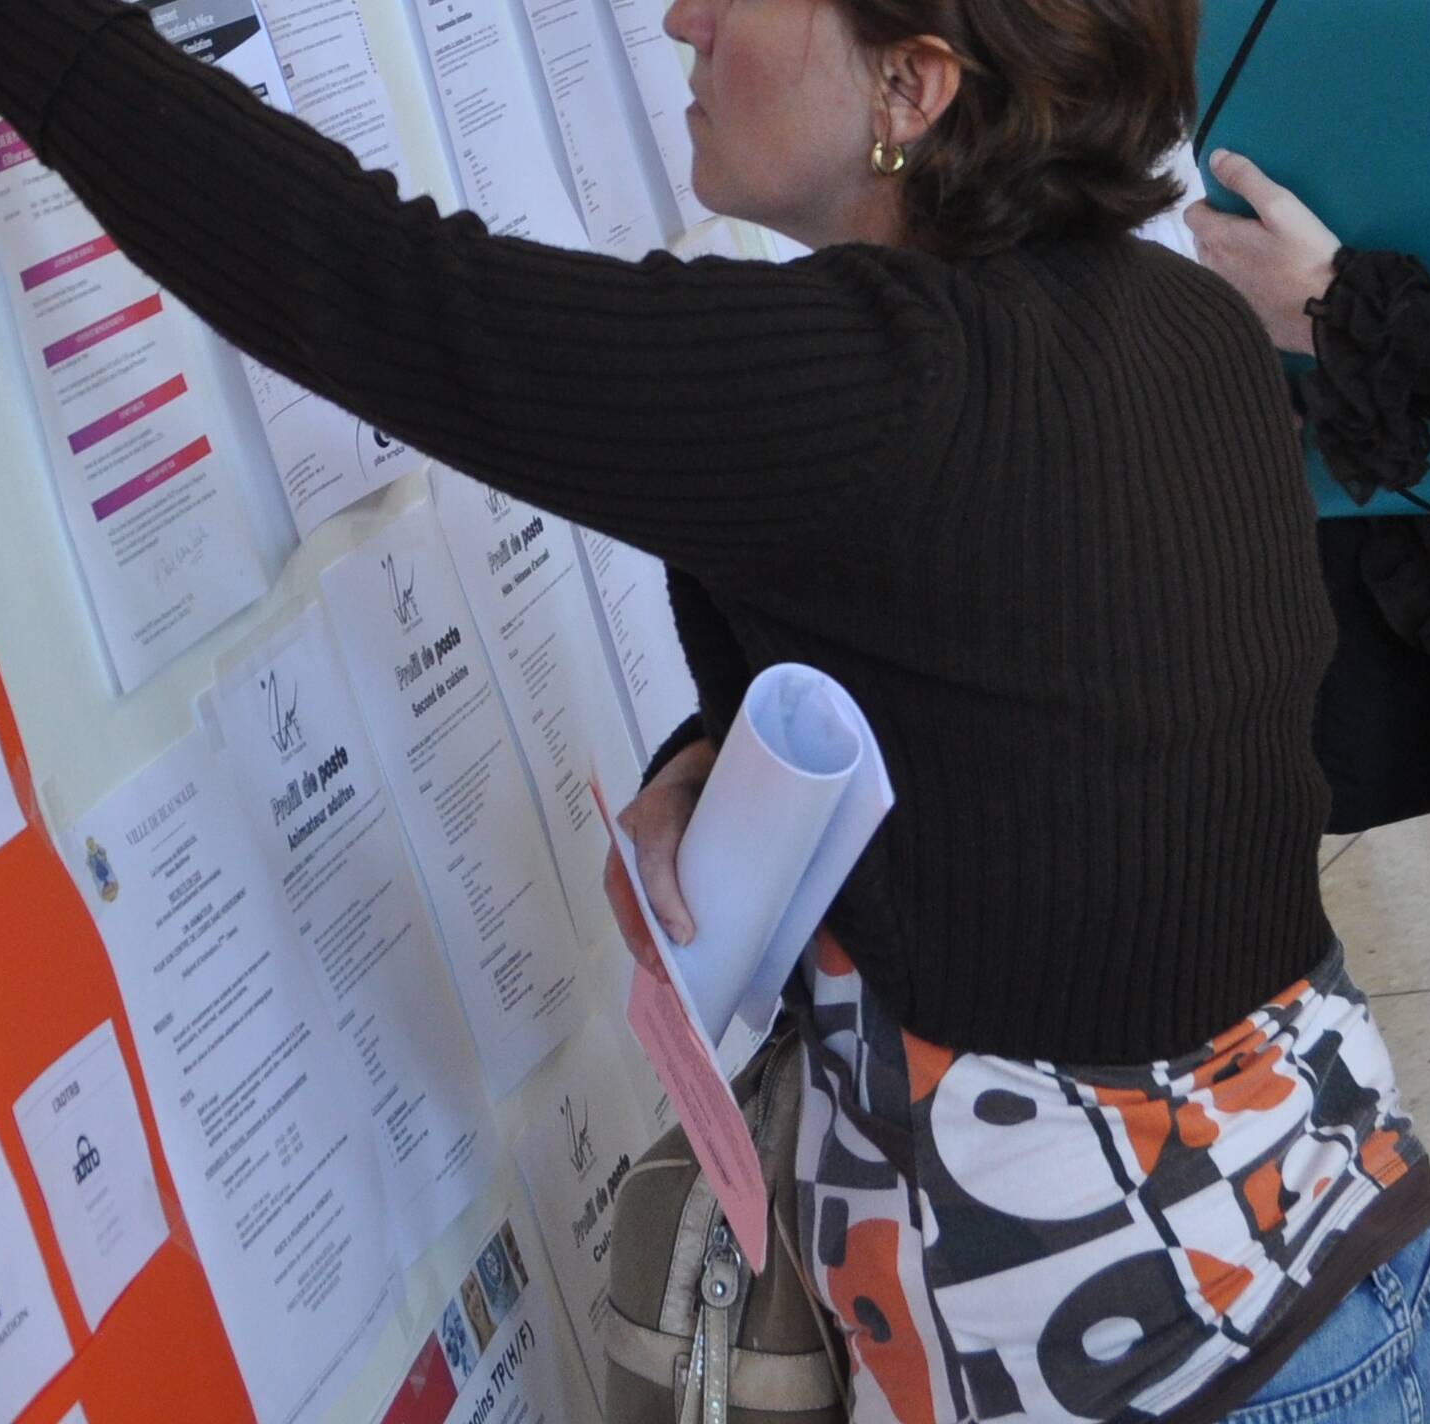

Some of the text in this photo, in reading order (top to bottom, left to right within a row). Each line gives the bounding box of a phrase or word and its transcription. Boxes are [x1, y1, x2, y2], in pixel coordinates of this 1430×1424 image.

[509, 532, 523, 556] de
[520, 514, 544, 553] poste
[393, 623, 462, 692] Profil de poste
[411, 687, 438, 718] Second
[444, 664, 470, 691] cuisine
[270, 744, 349, 827] Profil de poste
[124, 817, 150, 847] VILLE
[286, 783, 356, 853] Animateur adultes
[571, 1196, 598, 1249] Profil
[606, 1152, 631, 1203] poste
[592, 1229, 612, 1263] Cui
